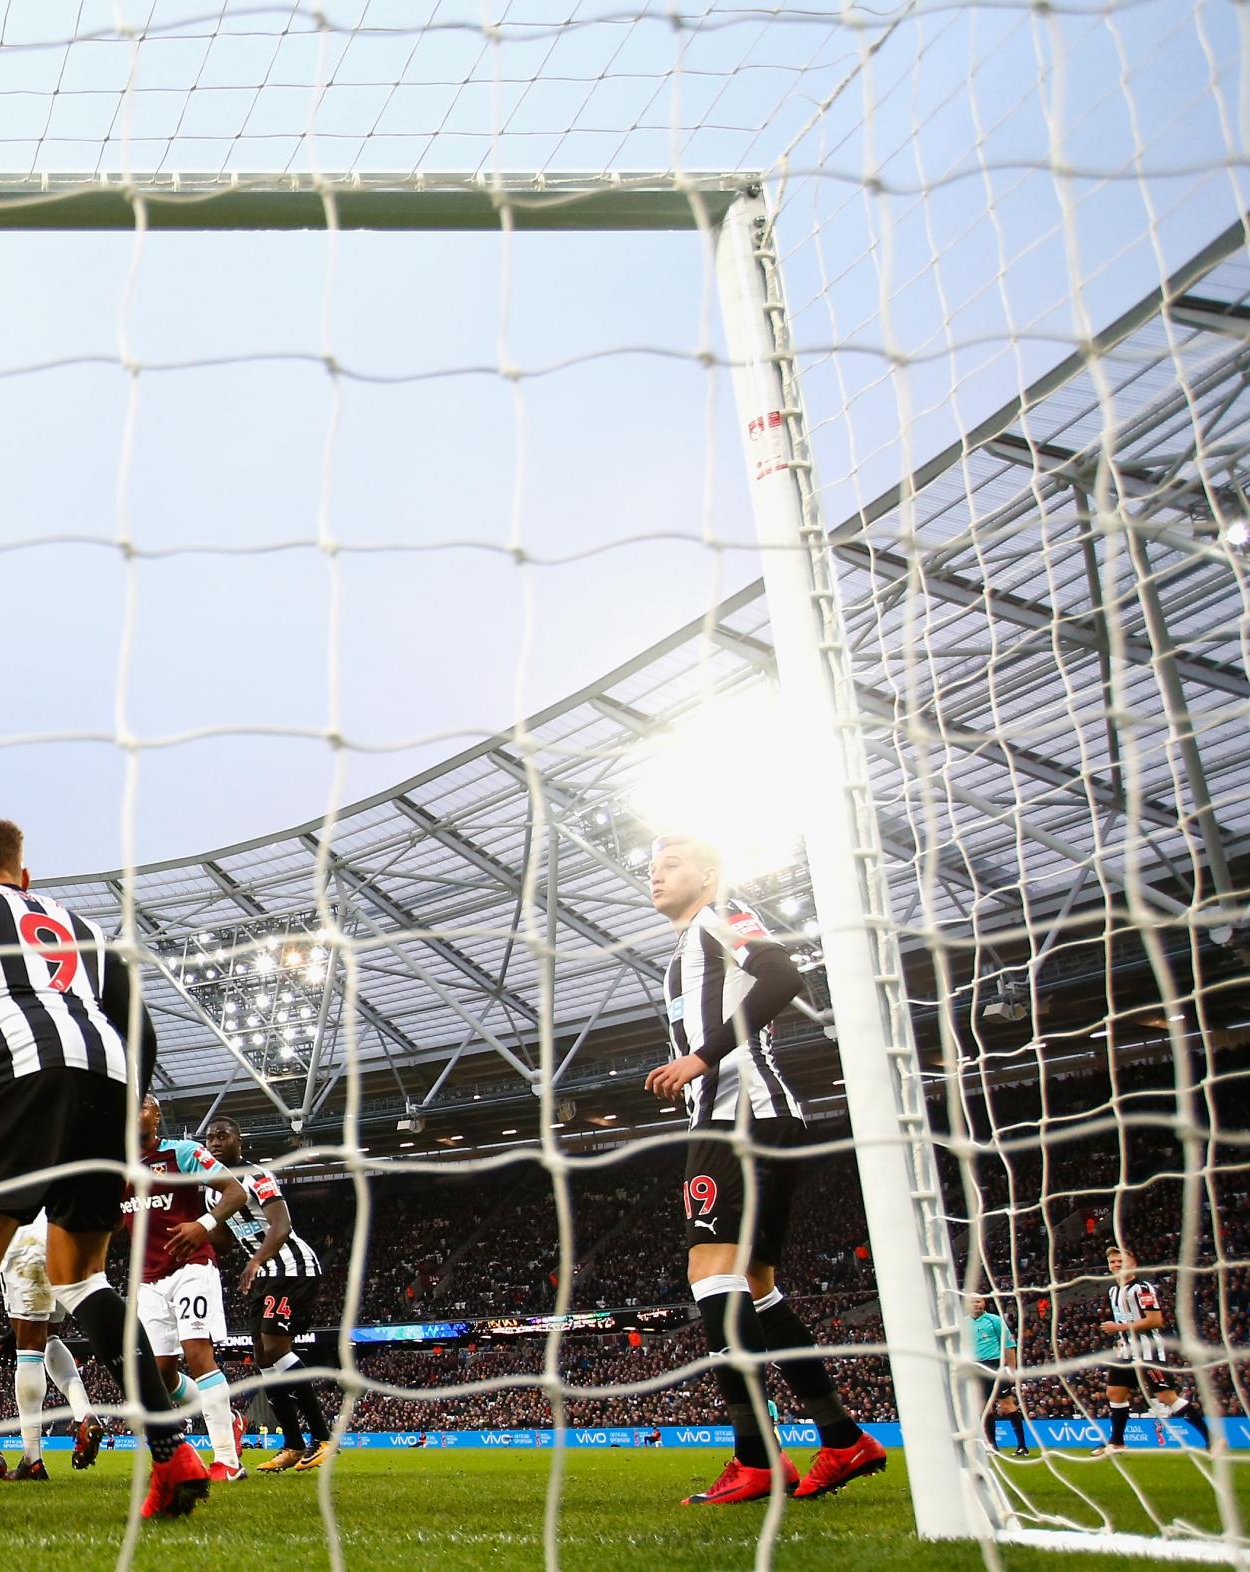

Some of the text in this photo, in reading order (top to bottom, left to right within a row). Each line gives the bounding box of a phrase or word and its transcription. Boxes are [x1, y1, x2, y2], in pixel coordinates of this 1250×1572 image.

[19, 911, 78, 993] 9
[683, 1175, 717, 1219] 19
[179, 1296, 208, 1320] 20
[263, 1295, 291, 1320] 24
[576, 1430, 607, 1444] vivo
[677, 1428, 711, 1442] vivo
[782, 1426, 817, 1442] vivo
[1048, 1423, 1102, 1442] vivo
